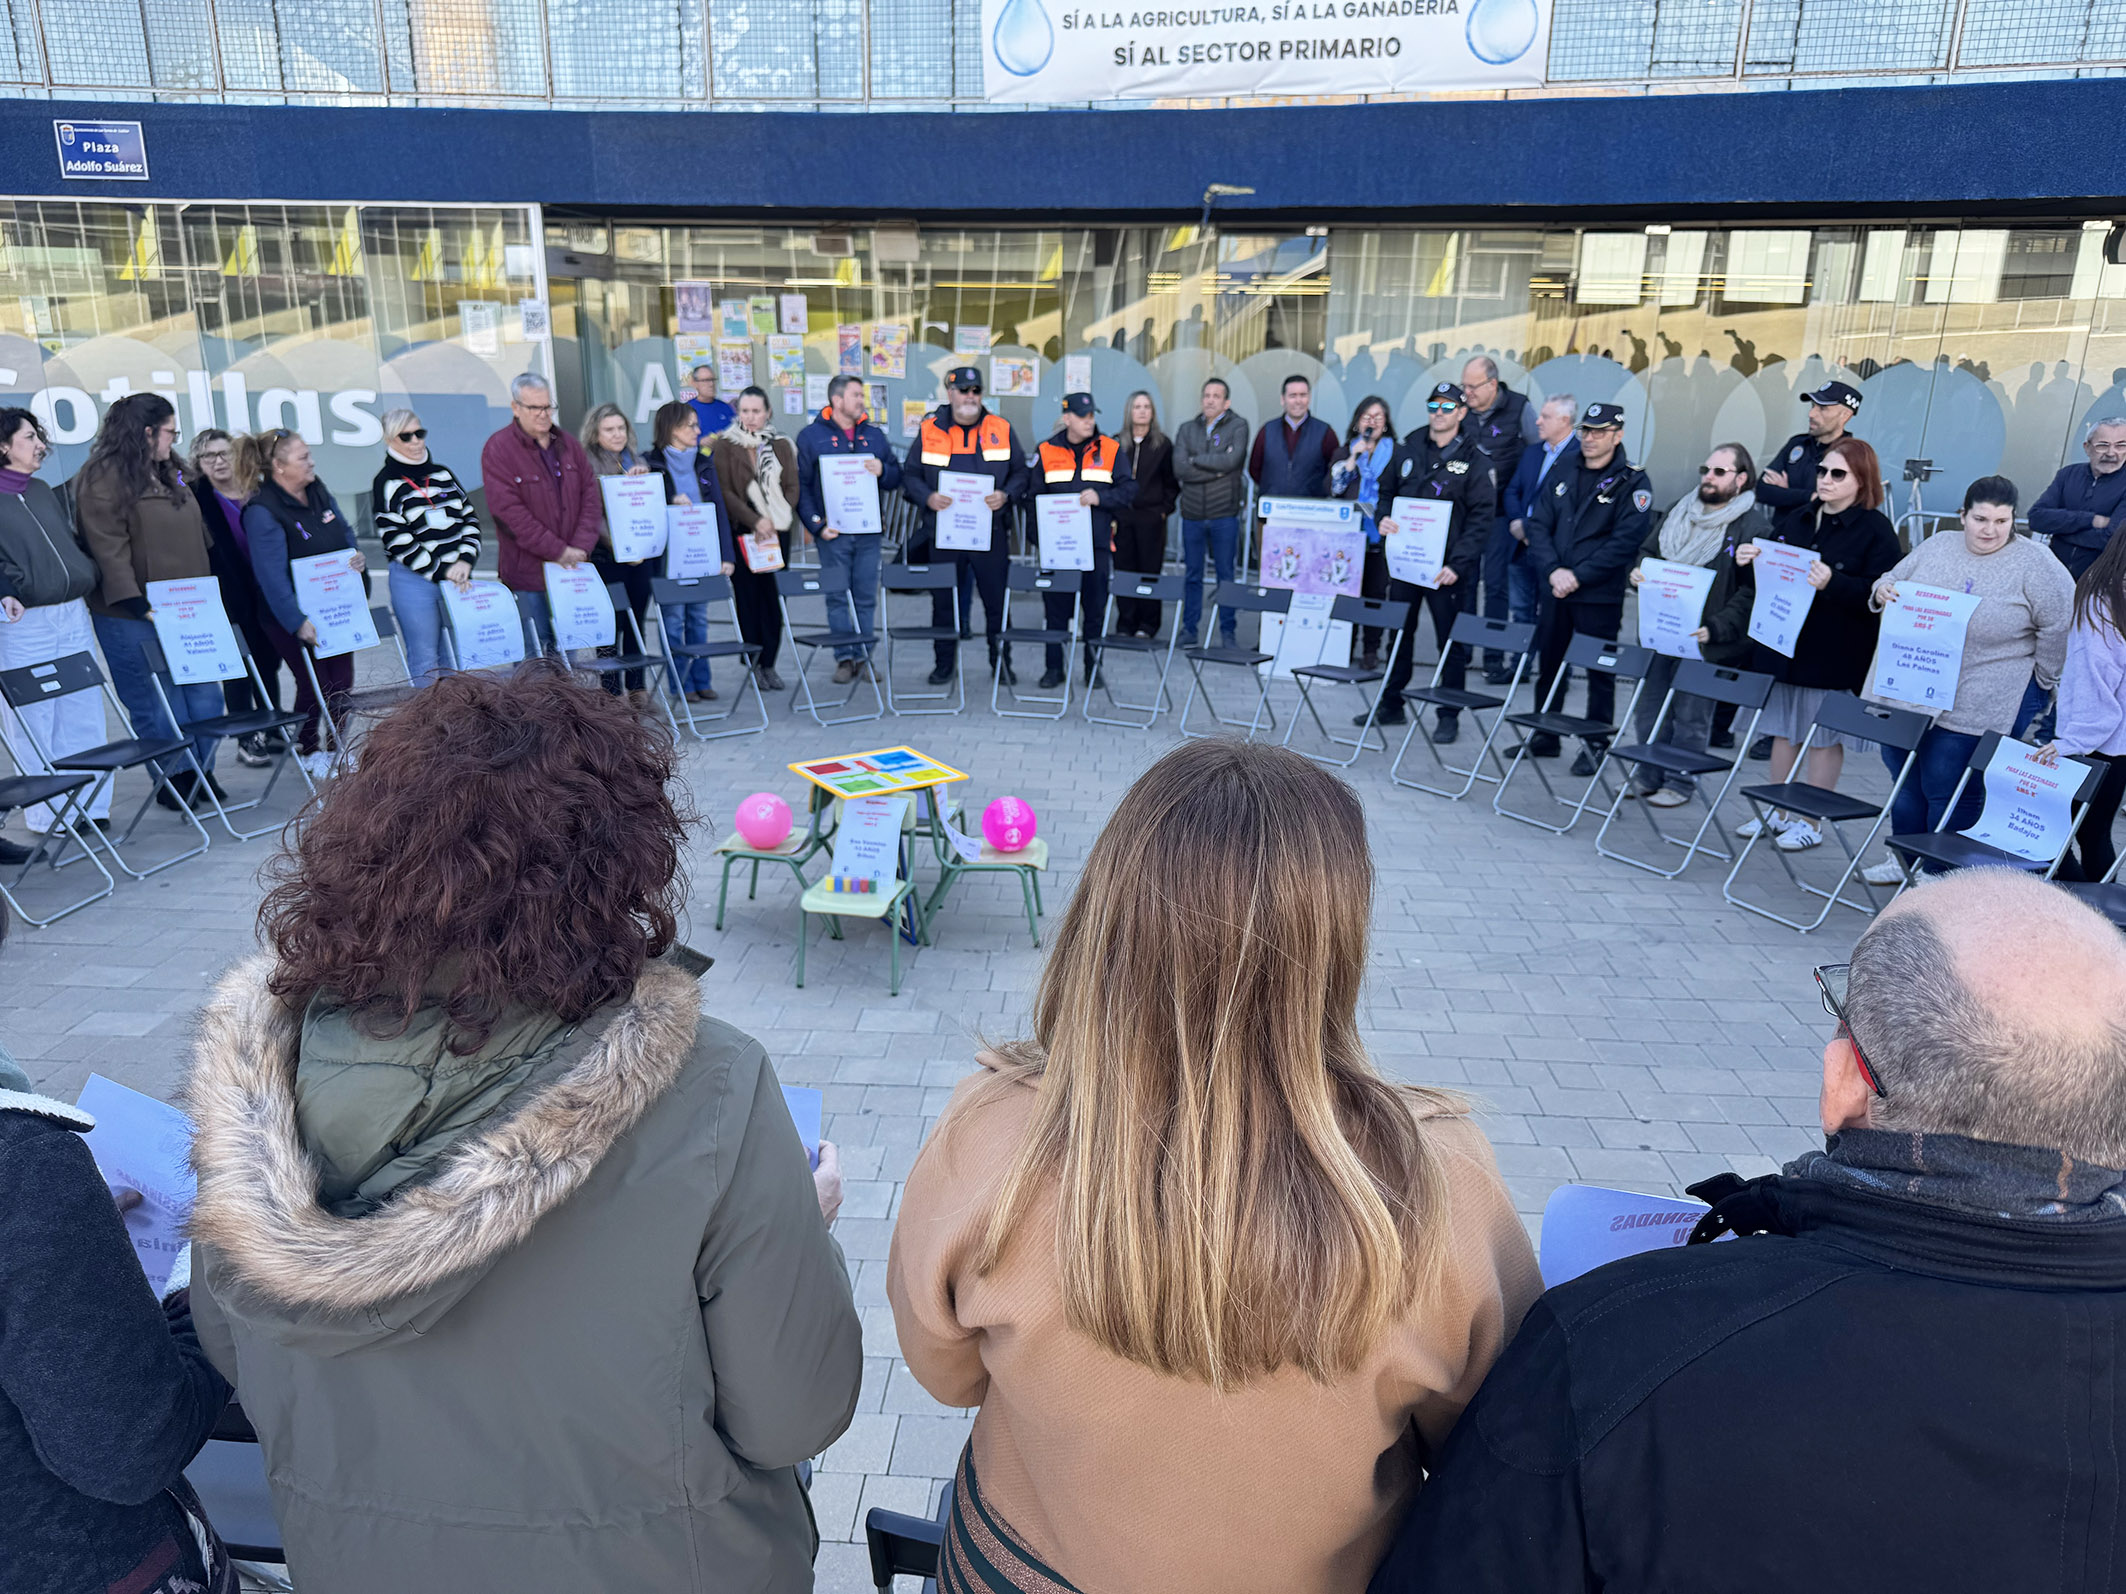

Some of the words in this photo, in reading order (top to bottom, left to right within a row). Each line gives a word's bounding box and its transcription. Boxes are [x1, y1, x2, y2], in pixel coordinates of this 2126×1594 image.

[1063, 9, 1080, 29] SÍ
[1084, 13, 1096, 29] A
[1101, 13, 1124, 28] LA
[1130, 6, 1266, 27] AGRICULTURA,
[1272, 0, 1288, 20] SÍ
[1294, 5, 1307, 20] A
[1313, 3, 1337, 19] LA
[1115, 41, 1134, 66] SÍ
[1141, 47, 1170, 66] AL
[1178, 41, 1271, 64] SECTOR
[1280, 37, 1402, 60] PRIMARIO
[82, 141, 120, 153] Plaza
[66, 160, 102, 172] Adolfo
[104, 160, 143, 173] Suárez
[1892, 642, 1914, 652] Diana
[1916, 646, 1950, 658] Carolina
[1897, 660, 1910, 668] Las
[1912, 663, 1940, 675] Palmas
[1914, 654, 1937, 665] AÑOS
[2009, 812, 2020, 821] 34
[2021, 817, 2045, 832] AÑOS
[2008, 821, 2040, 840] Badajoz
